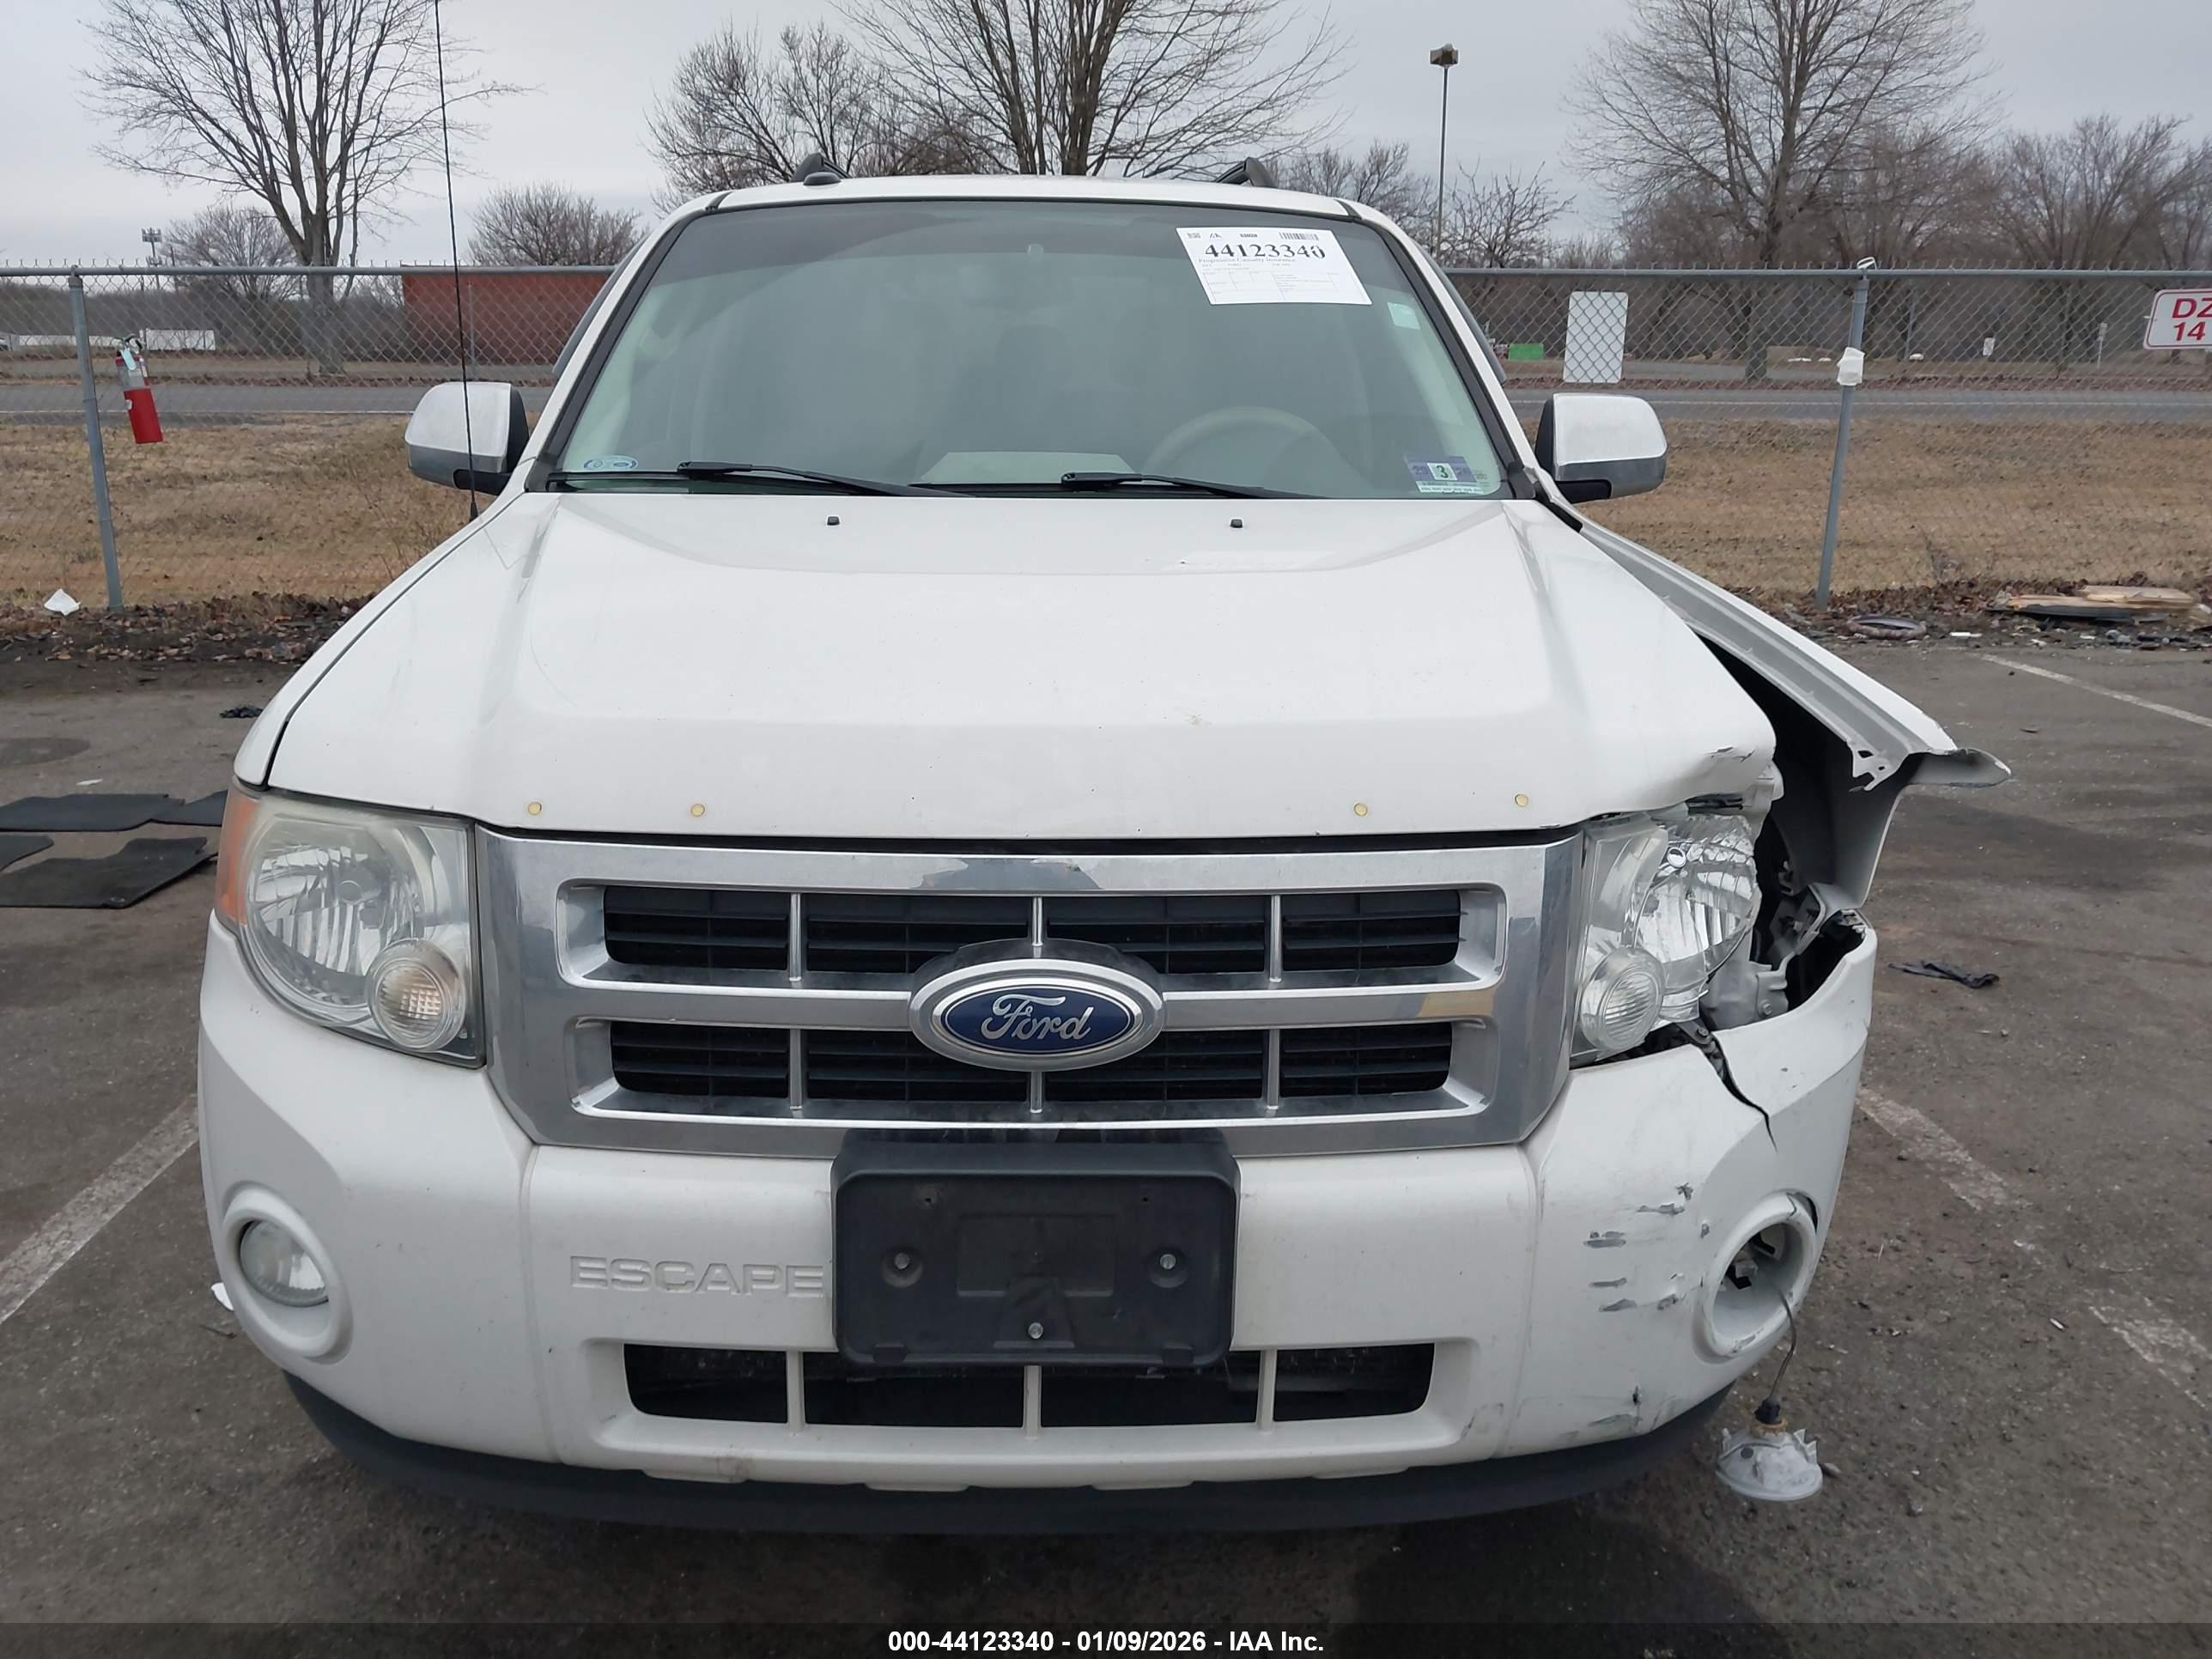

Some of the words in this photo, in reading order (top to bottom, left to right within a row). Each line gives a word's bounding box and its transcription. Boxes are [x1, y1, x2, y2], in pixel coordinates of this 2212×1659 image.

[1205, 244, 1326, 258] 44123340
[981, 994, 1095, 1040] Ford
[569, 1255, 824, 1298] ESCAPE
